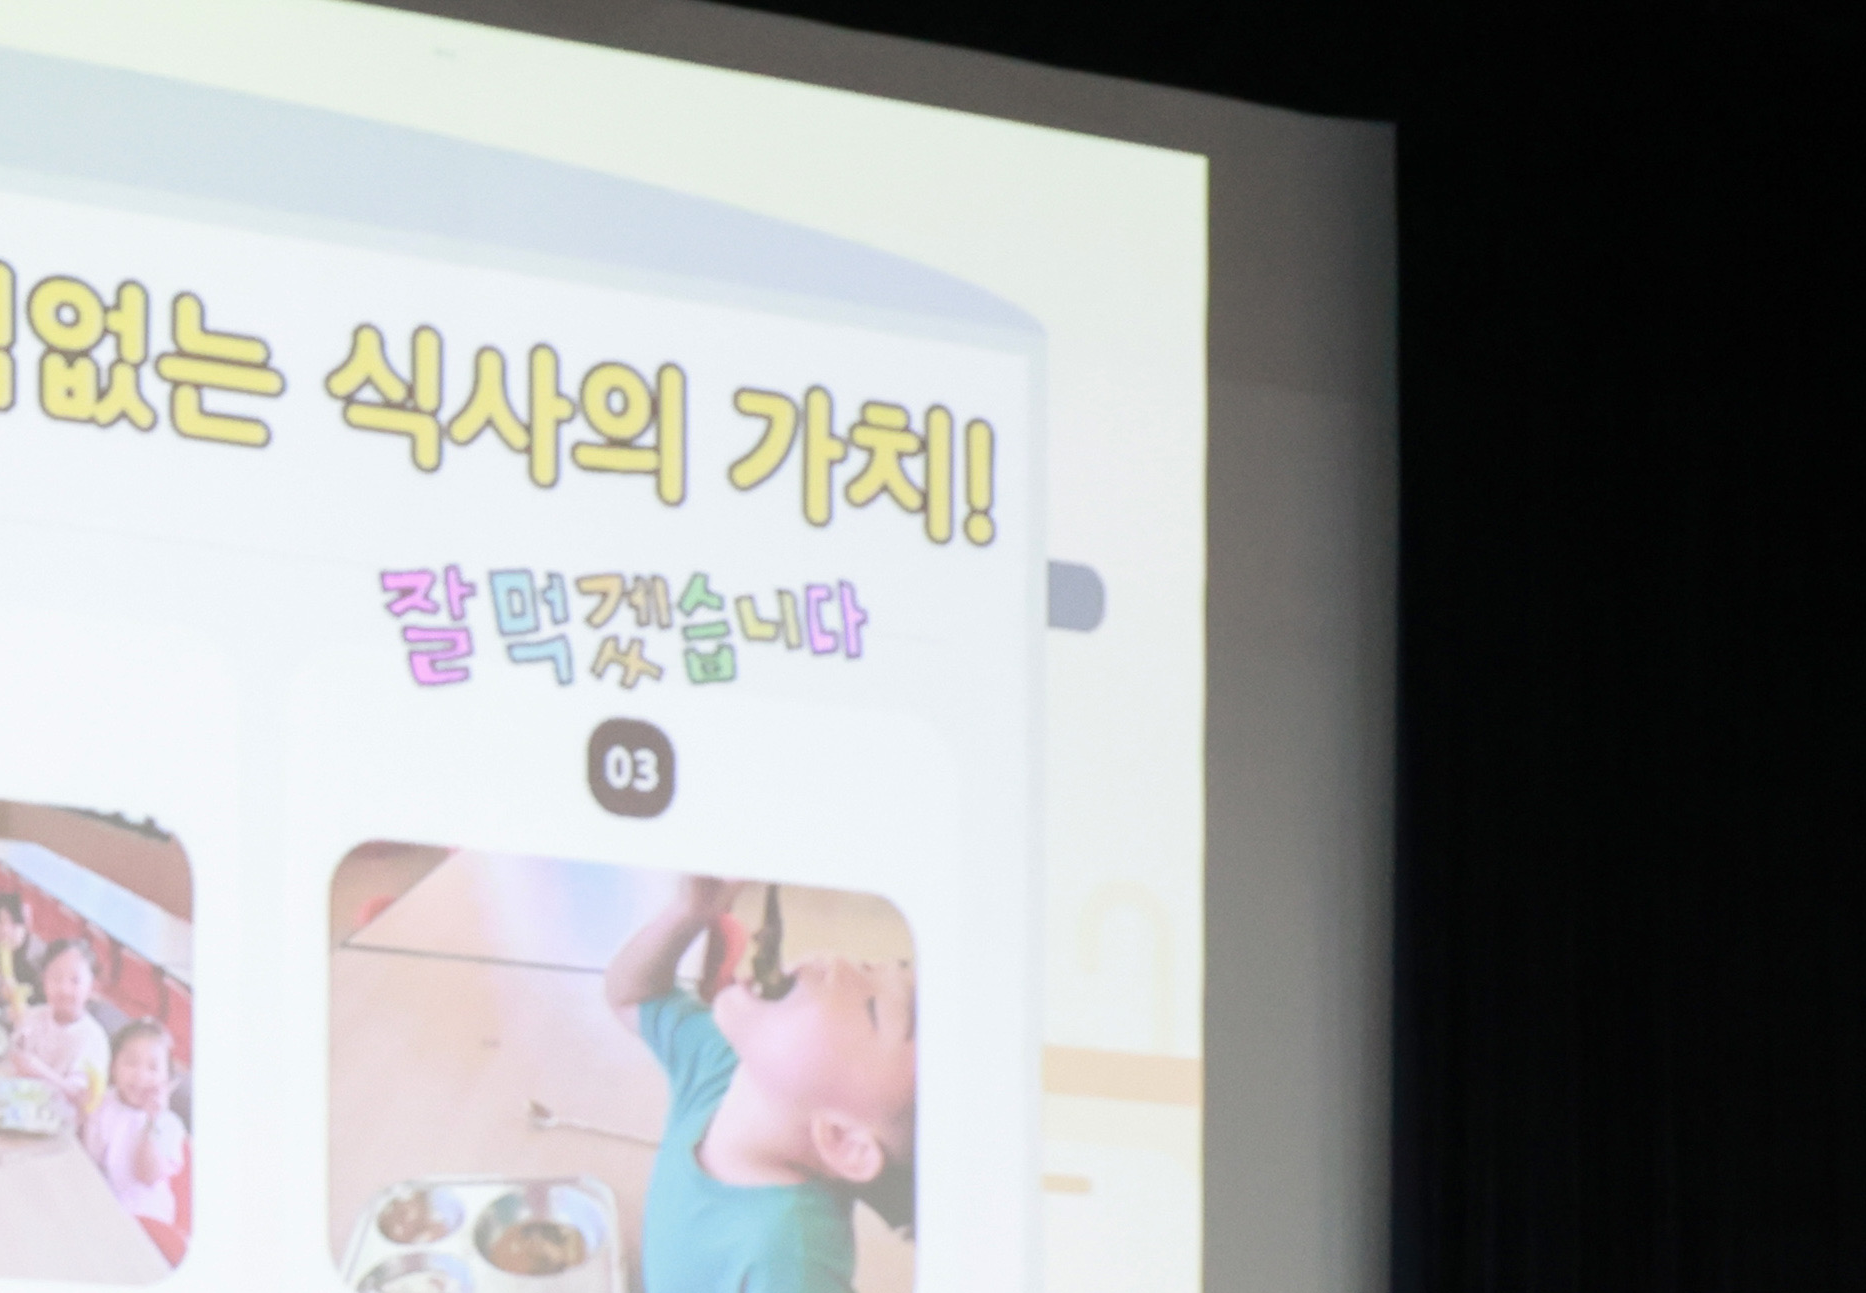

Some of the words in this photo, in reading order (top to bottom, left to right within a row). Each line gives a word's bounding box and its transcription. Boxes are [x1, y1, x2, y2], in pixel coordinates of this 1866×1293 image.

[323, 322, 688, 508] 식사의
[726, 384, 996, 548] 가치!
[604, 745, 659, 792] 03
